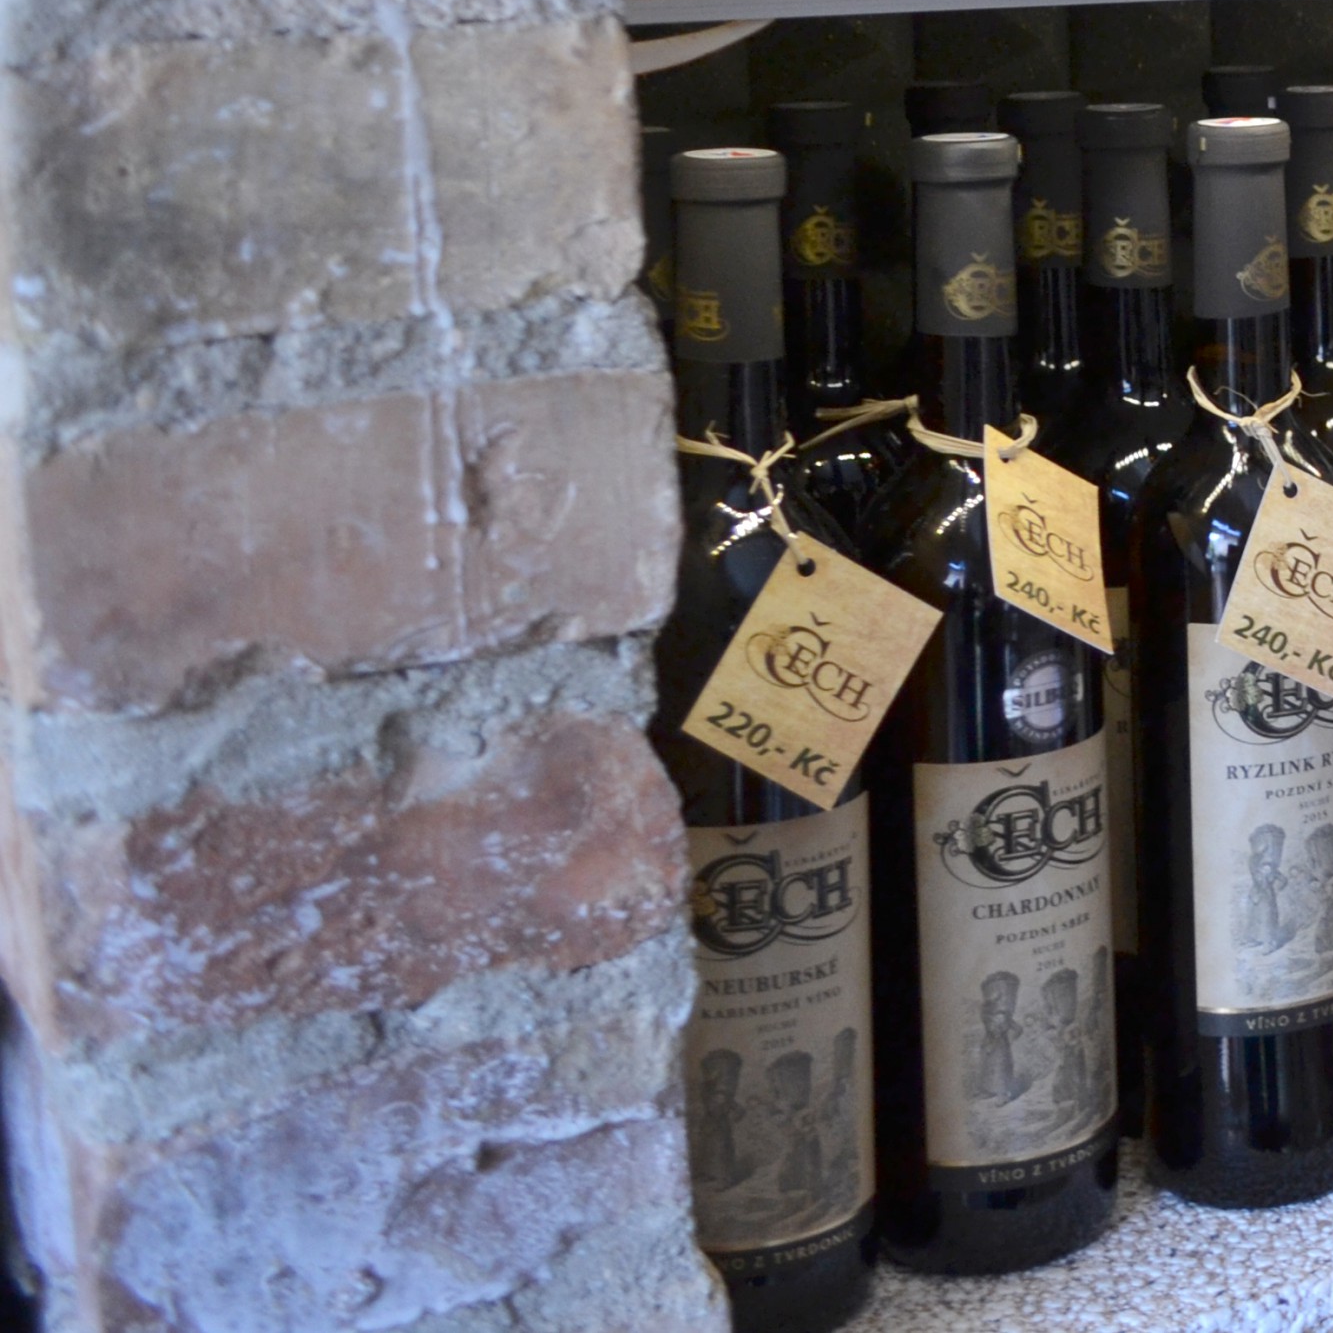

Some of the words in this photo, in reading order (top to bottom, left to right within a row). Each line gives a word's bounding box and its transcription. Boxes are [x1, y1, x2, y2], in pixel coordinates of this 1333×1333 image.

[1006, 571, 1064, 617] 240,-
[1072, 605, 1102, 634] Kč
[1233, 614, 1302, 661] 240,-
[706, 701, 787, 762] 220,-
[790, 746, 839, 787] Kč
[1226, 756, 1315, 781] RYZLINK
[1265, 781, 1323, 801] POZDNÍ
[971, 873, 1102, 921] CHARDONNAY
[703, 957, 838, 997] NEUBURSKÉ
[1245, 1011, 1290, 1031] VÍNO
